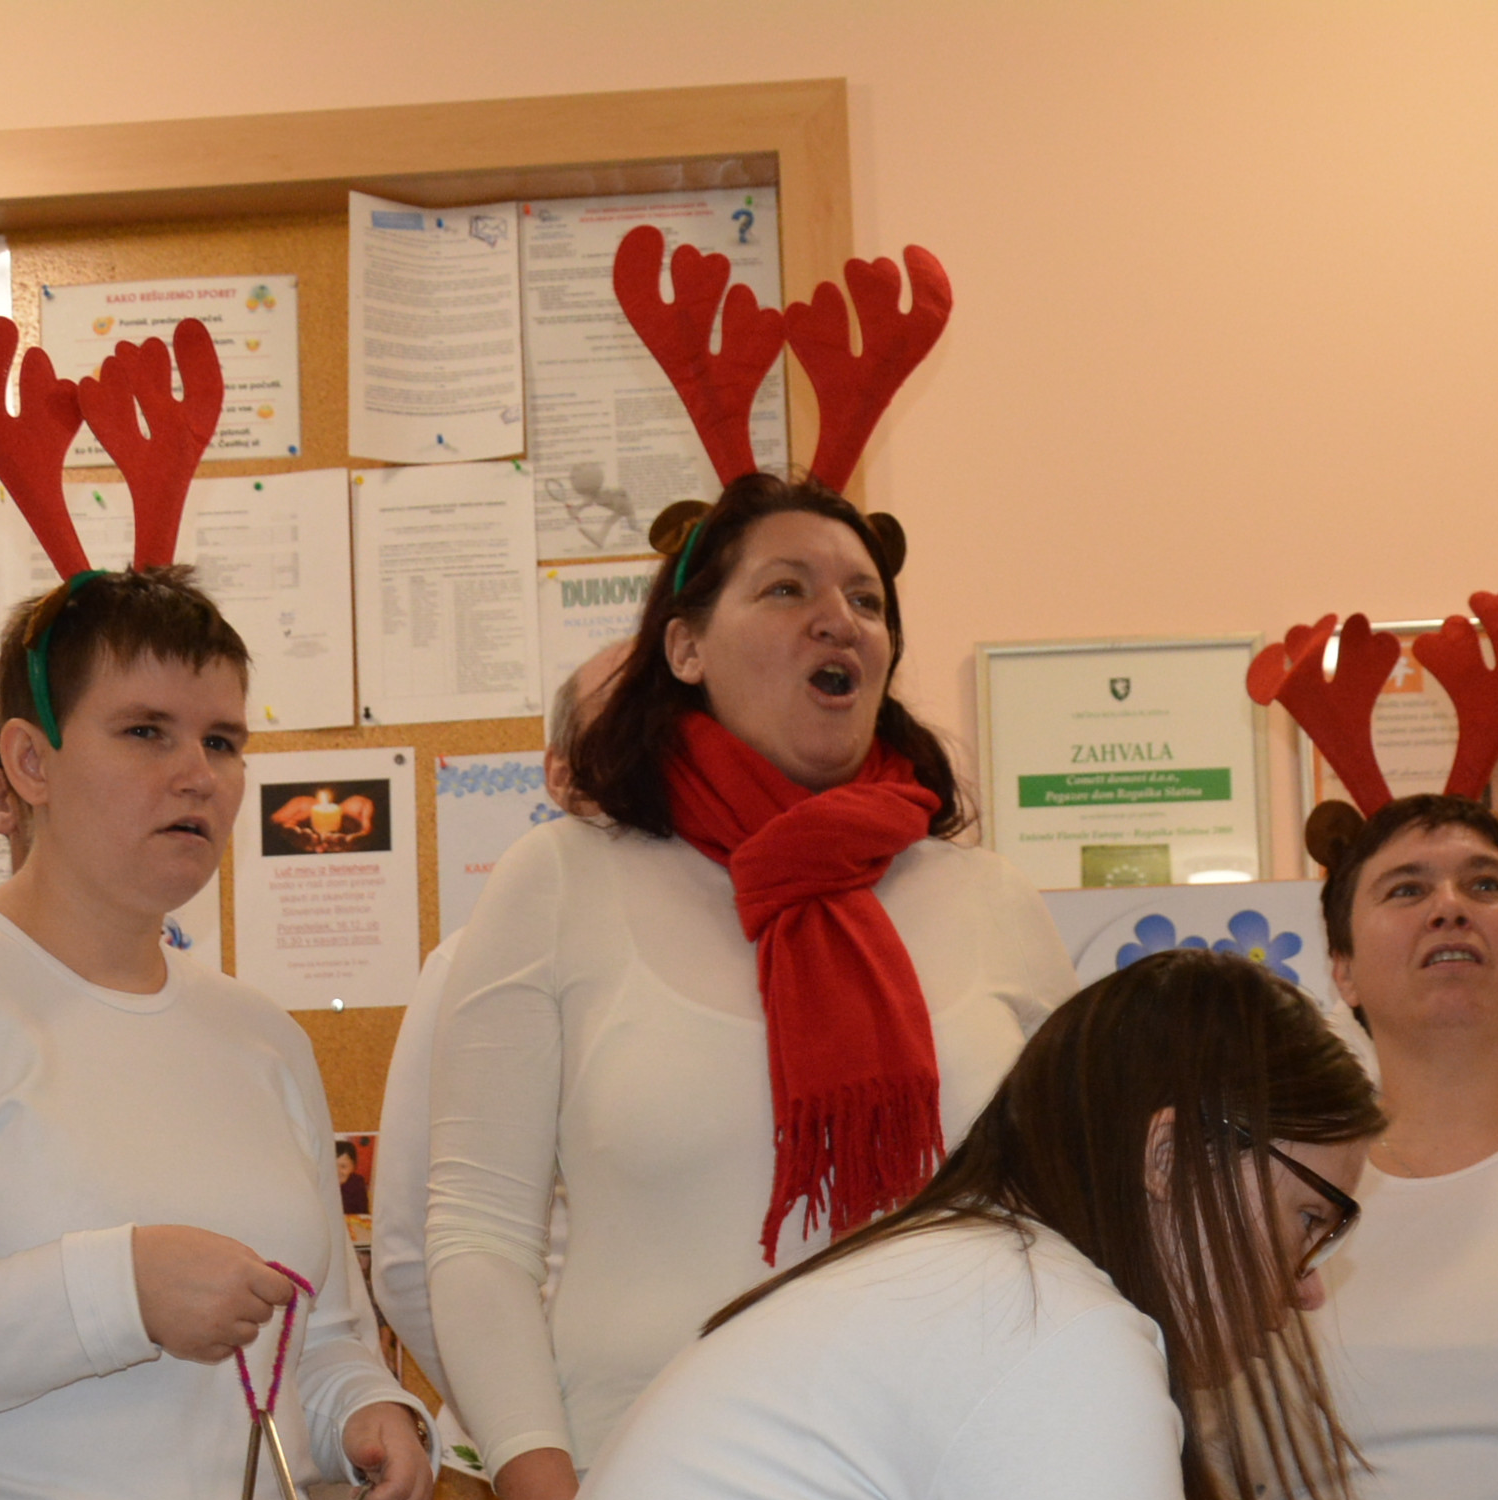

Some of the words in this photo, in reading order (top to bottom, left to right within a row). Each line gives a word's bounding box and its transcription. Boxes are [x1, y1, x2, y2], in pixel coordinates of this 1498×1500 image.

[106, 293, 137, 304] KAKO
[140, 289, 195, 302] REŠUJEMO
[1070, 742, 1174, 763] ZAHVALA
[464, 861, 496, 874] KAK
